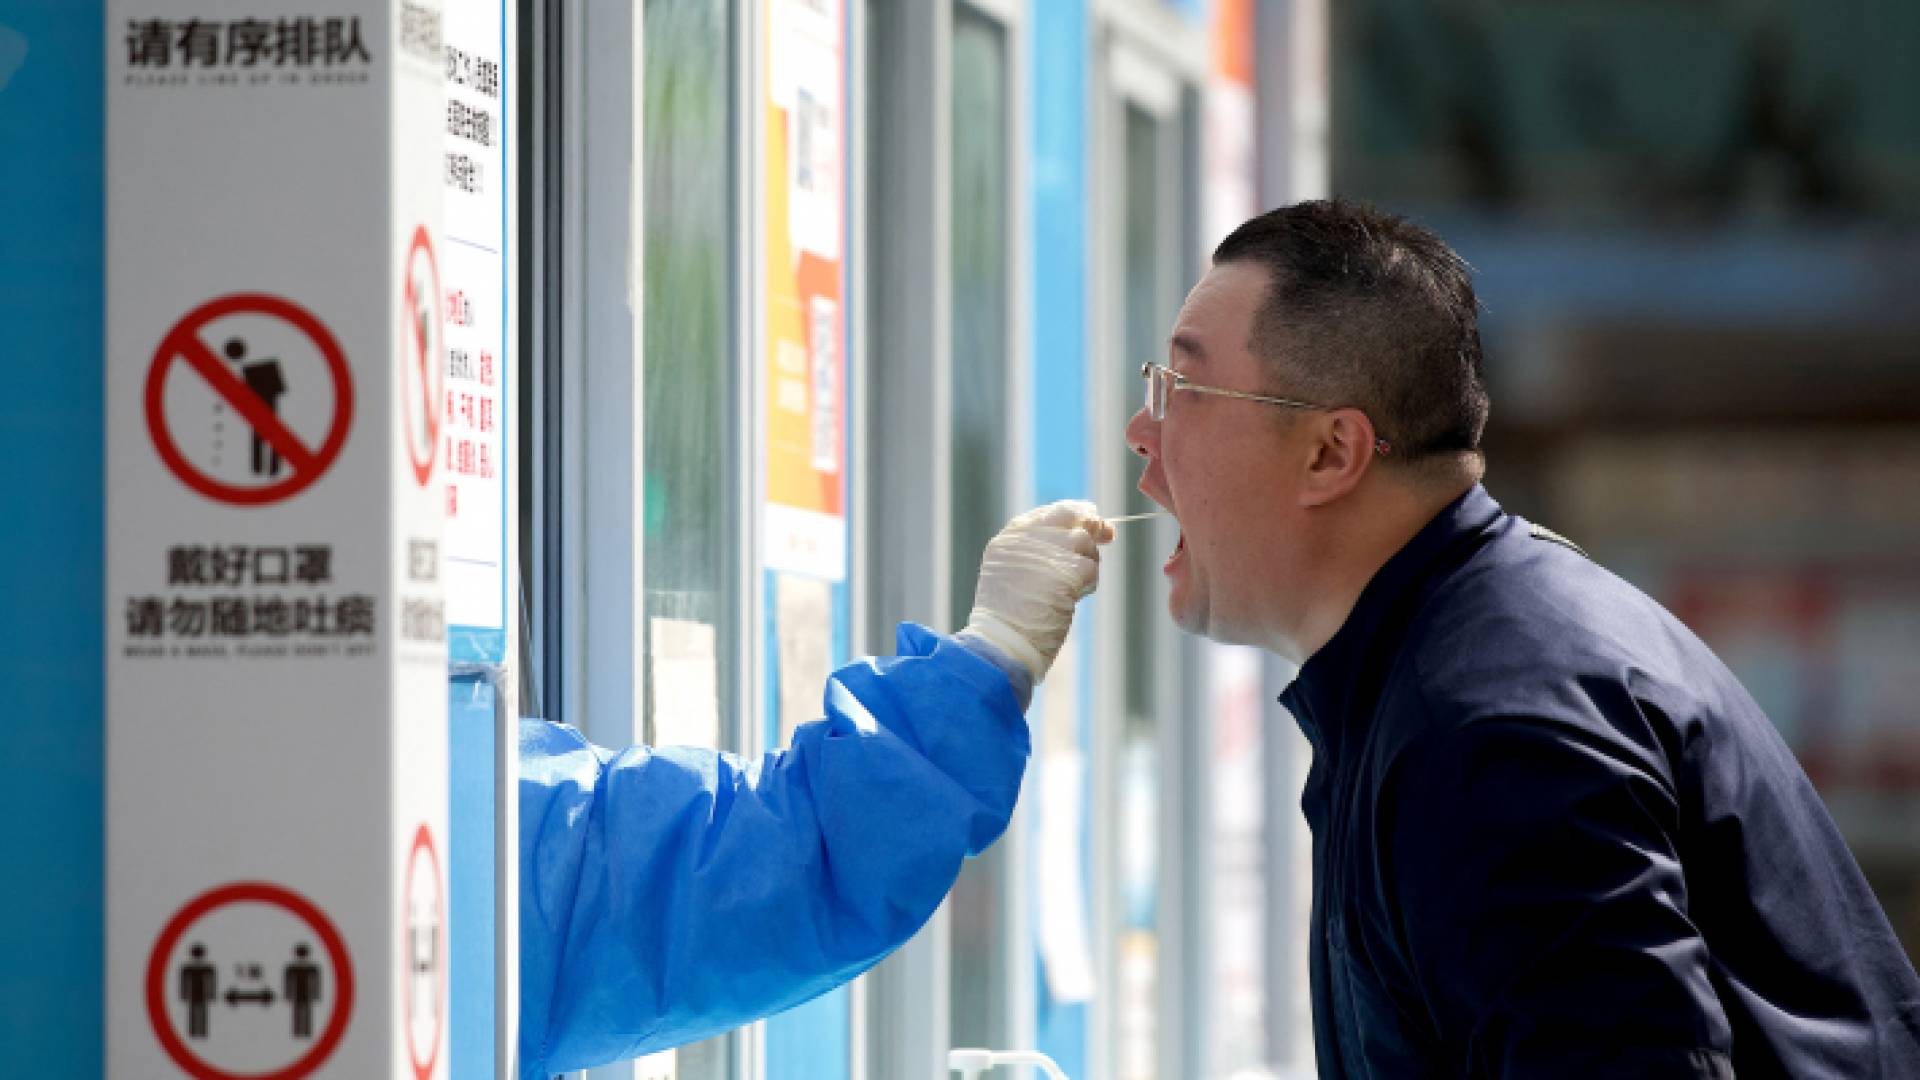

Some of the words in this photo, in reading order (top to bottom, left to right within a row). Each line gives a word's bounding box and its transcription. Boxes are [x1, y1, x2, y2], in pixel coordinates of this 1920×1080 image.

[125, 17, 370, 67] 请有序排队
[167, 545, 332, 586] 戴好口罩
[126, 595, 374, 638] 请勿随地吐痰
